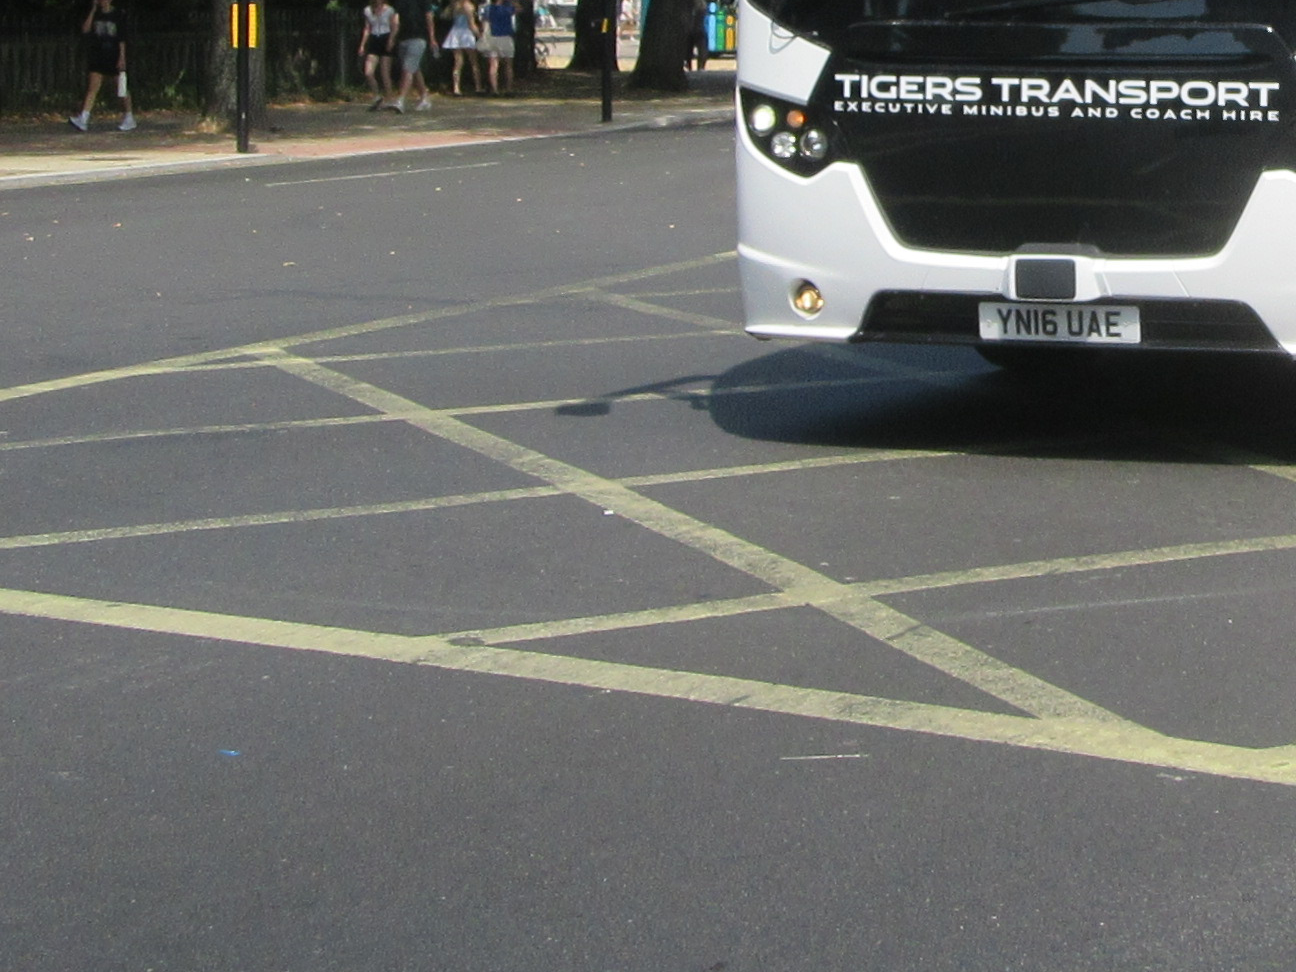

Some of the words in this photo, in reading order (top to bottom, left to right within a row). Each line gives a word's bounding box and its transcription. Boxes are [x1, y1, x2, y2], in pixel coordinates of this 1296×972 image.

[834, 73, 983, 101] TIGERS
[990, 77, 1280, 107] TRANSPORT
[834, 100, 953, 115] EXECUTIVE
[963, 104, 1060, 118] MINIBUS
[1070, 106, 1119, 119] AND
[1130, 107, 1211, 121] COACH
[1222, 109, 1280, 122] HIRE
[996, 308, 1058, 336] YN16
[1066, 309, 1122, 338] UAE
